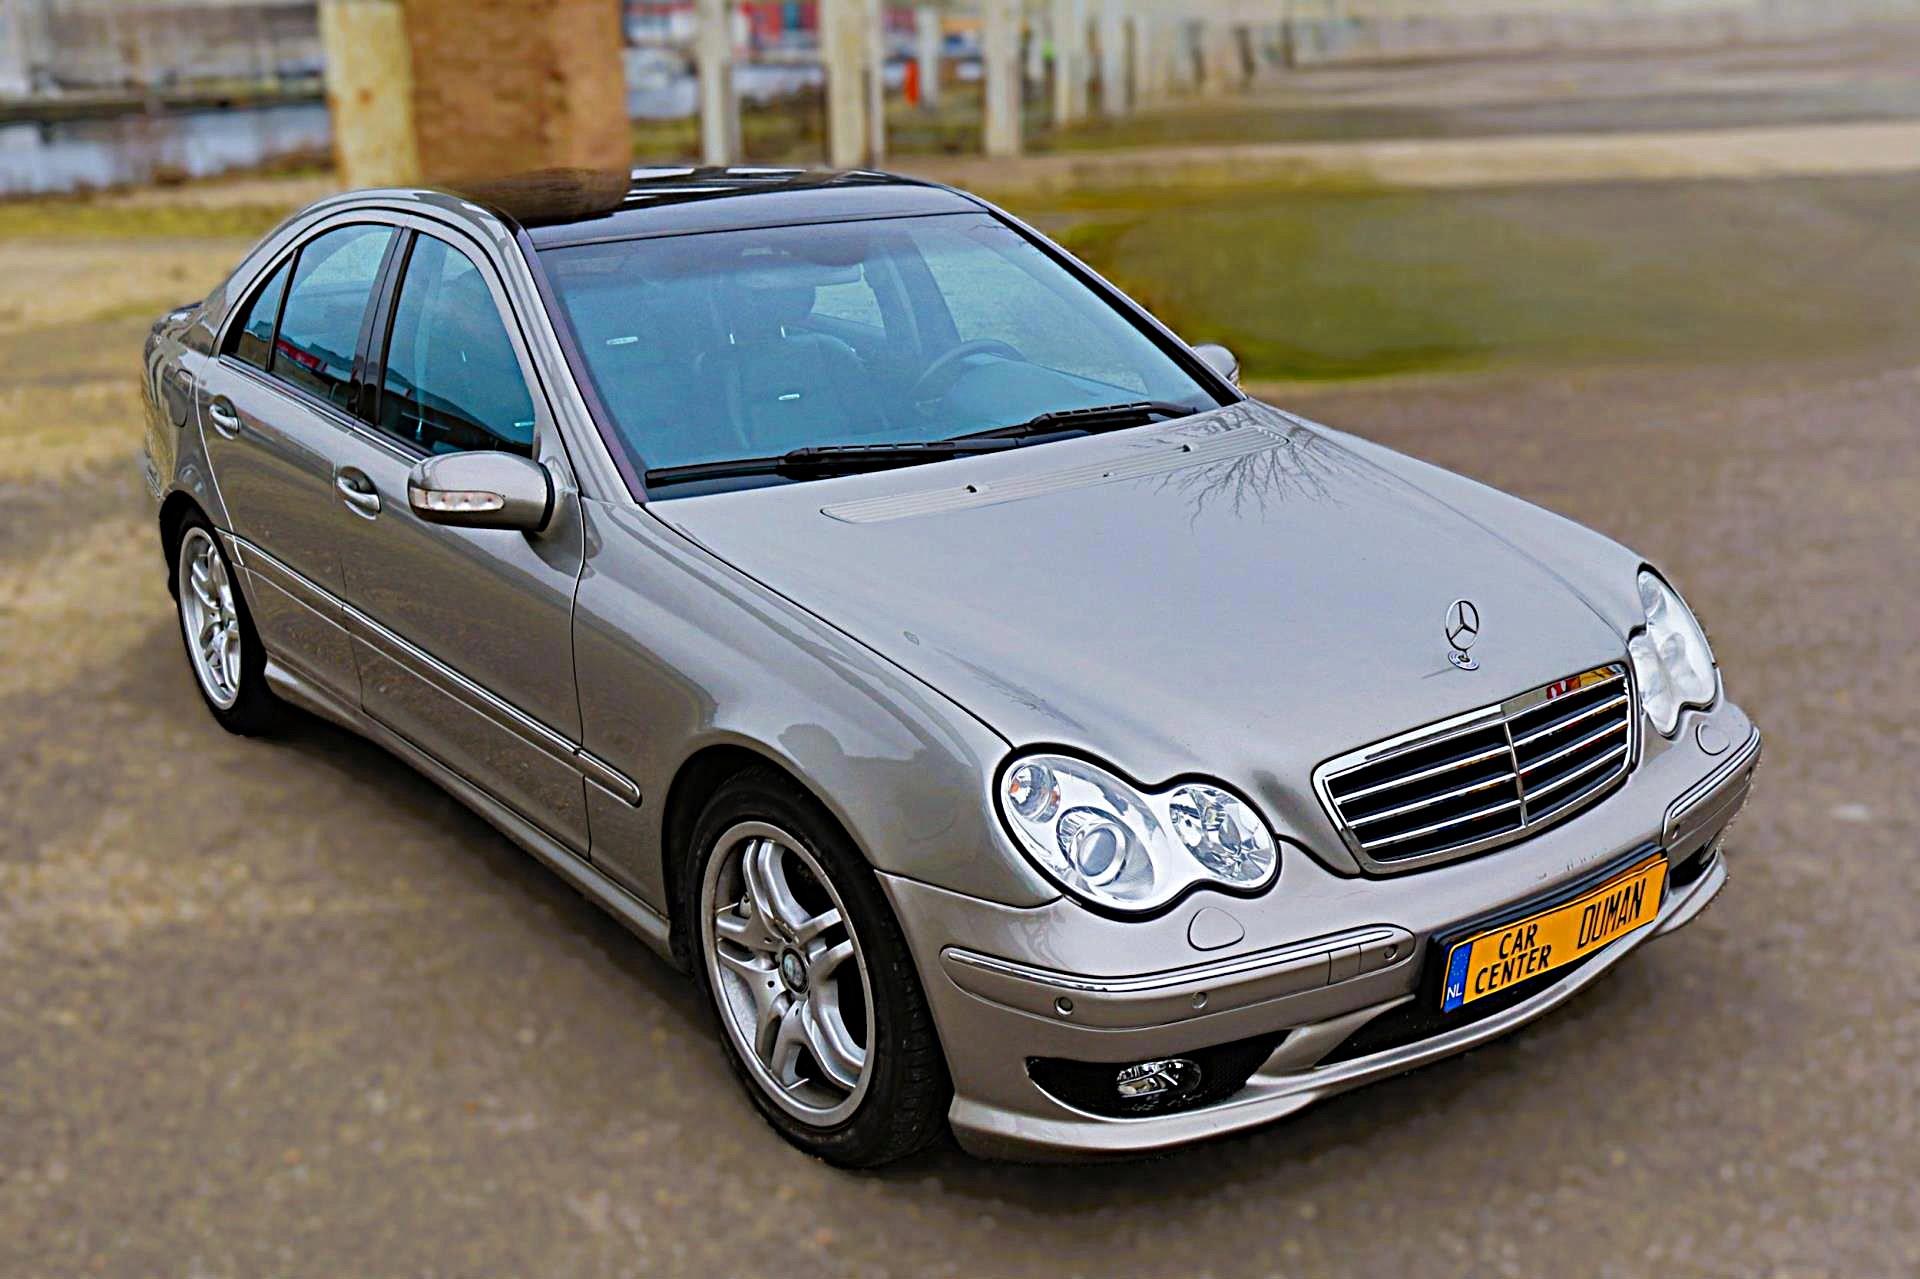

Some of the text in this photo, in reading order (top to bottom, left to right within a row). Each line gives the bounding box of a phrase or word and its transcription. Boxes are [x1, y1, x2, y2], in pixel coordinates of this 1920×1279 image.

[1577, 878, 1647, 949] DUMAN
[1499, 923, 1538, 960] CAR
[1475, 944, 1552, 994] CENTER
[1446, 983, 1462, 1000] NL
